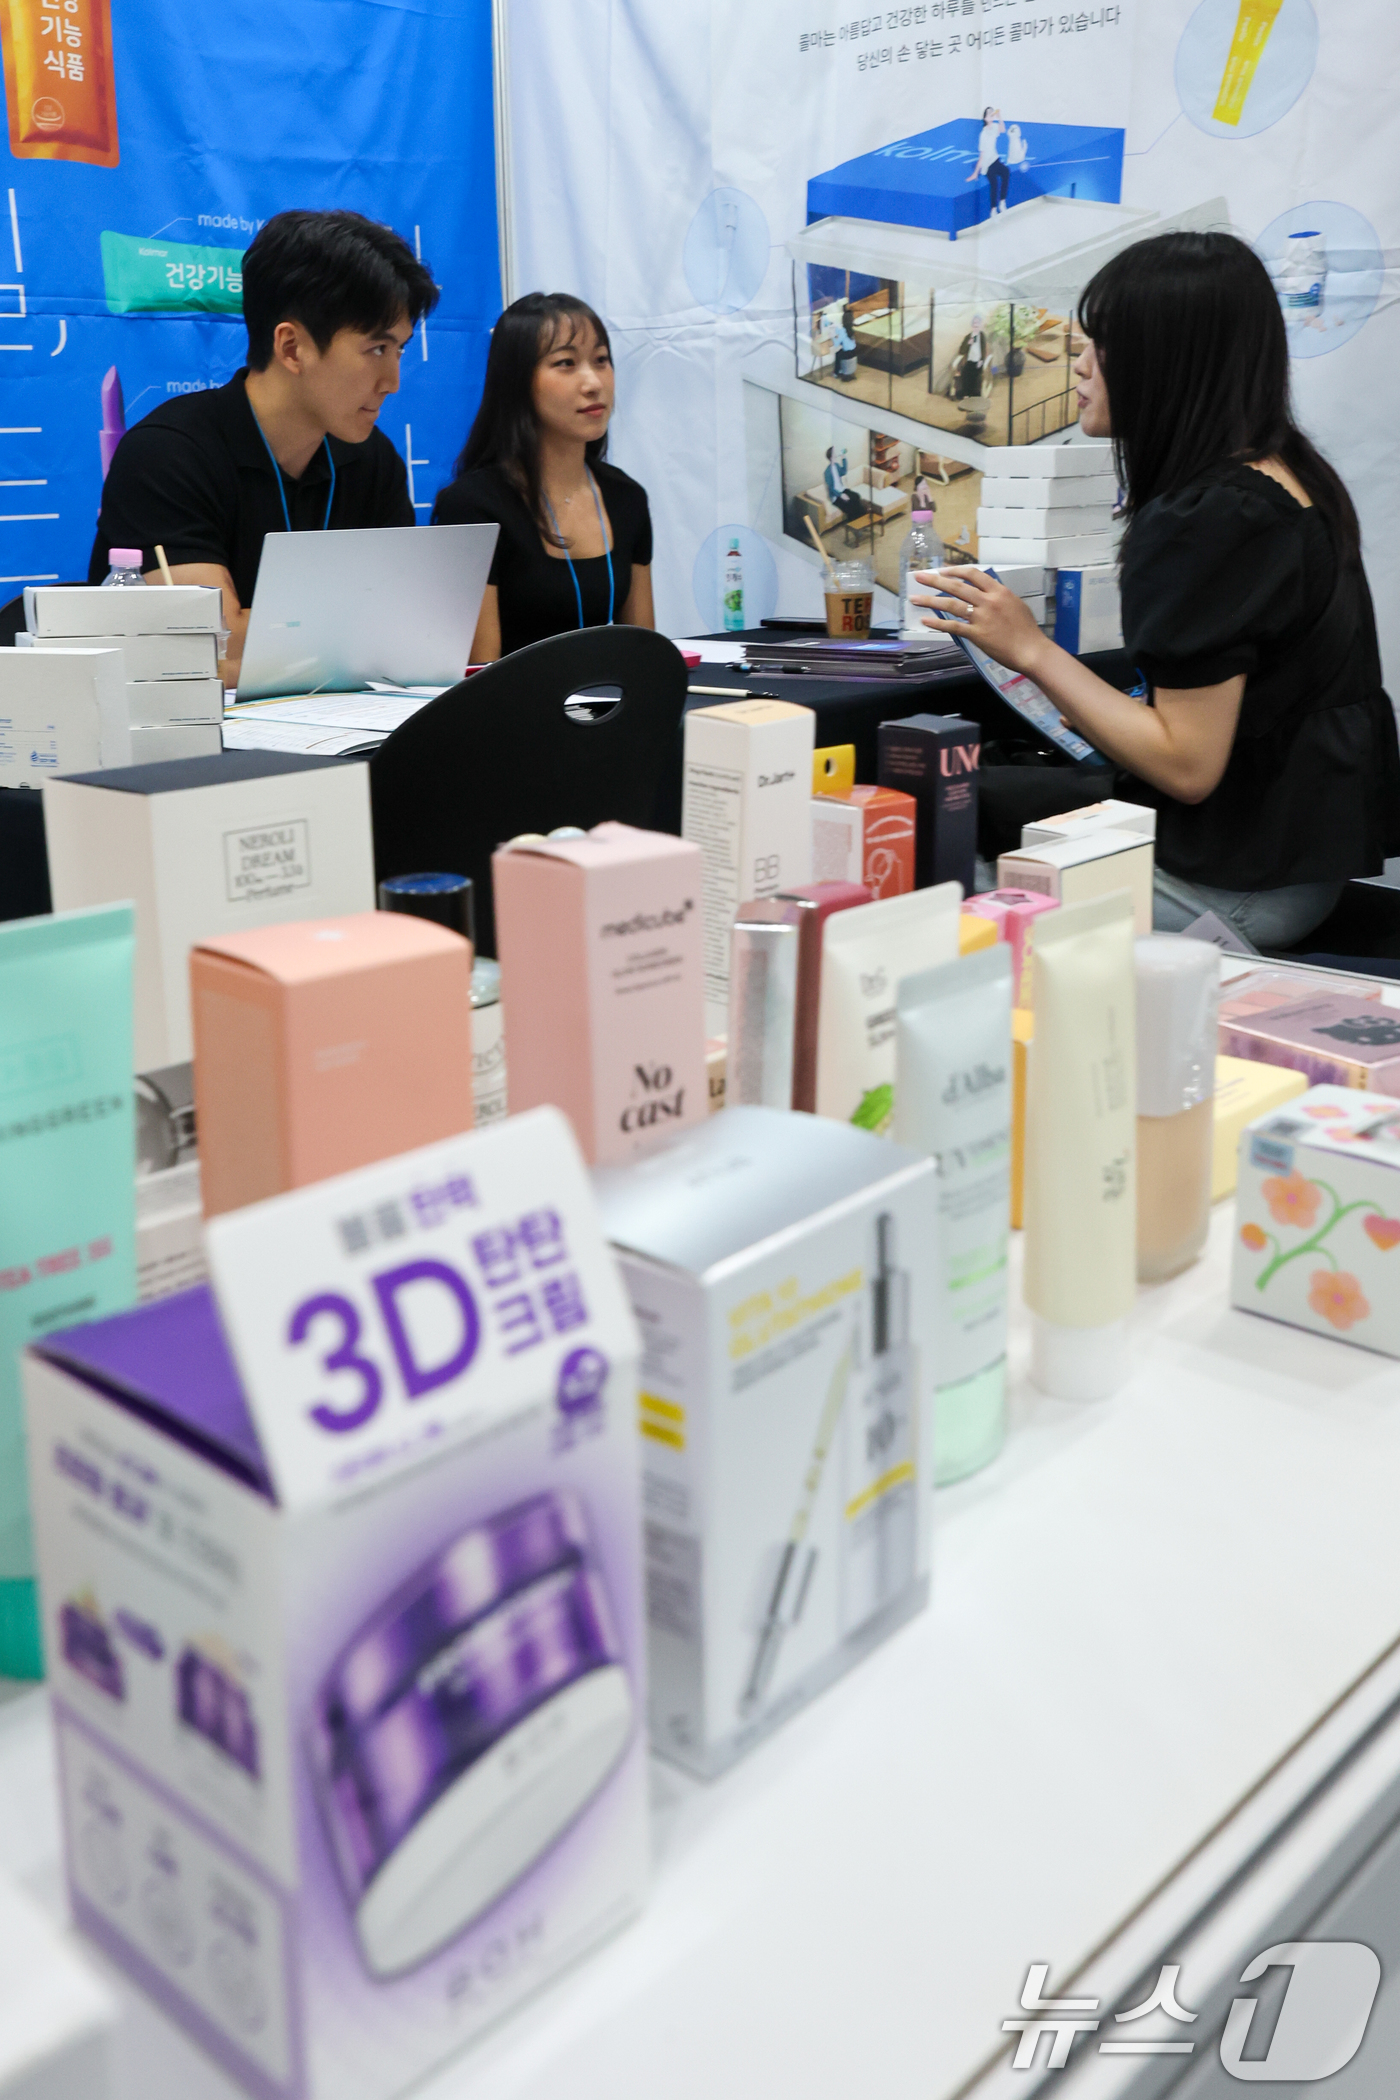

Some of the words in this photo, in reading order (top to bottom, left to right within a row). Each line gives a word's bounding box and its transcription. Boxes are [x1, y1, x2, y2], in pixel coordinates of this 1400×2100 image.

[40, 16, 82, 48] 기능
[799, 32, 835, 52] 콜마는
[839, 17, 882, 42] 아름답고
[886, 5, 927, 30] 건강한
[856, 46, 893, 71] 당신의
[897, 44, 911, 63] 손
[915, 39, 943, 59] 닿는
[947, 34, 962, 55] 곳
[966, 25, 1006, 50] 어디든
[1009, 16, 1053, 42] 콜마가
[1058, 5, 1121, 33] 있습니다
[43, 50, 85, 82] 식품
[198, 213, 238, 230] made
[240, 216, 254, 235] by
[238, 828, 294, 851] NEROLI
[241, 848, 295, 871] DREAM
[754, 853, 779, 883] BB
[631, 1063, 673, 1093] No
[619, 1088, 684, 1133] cast
[287, 1257, 481, 1436] 3D
